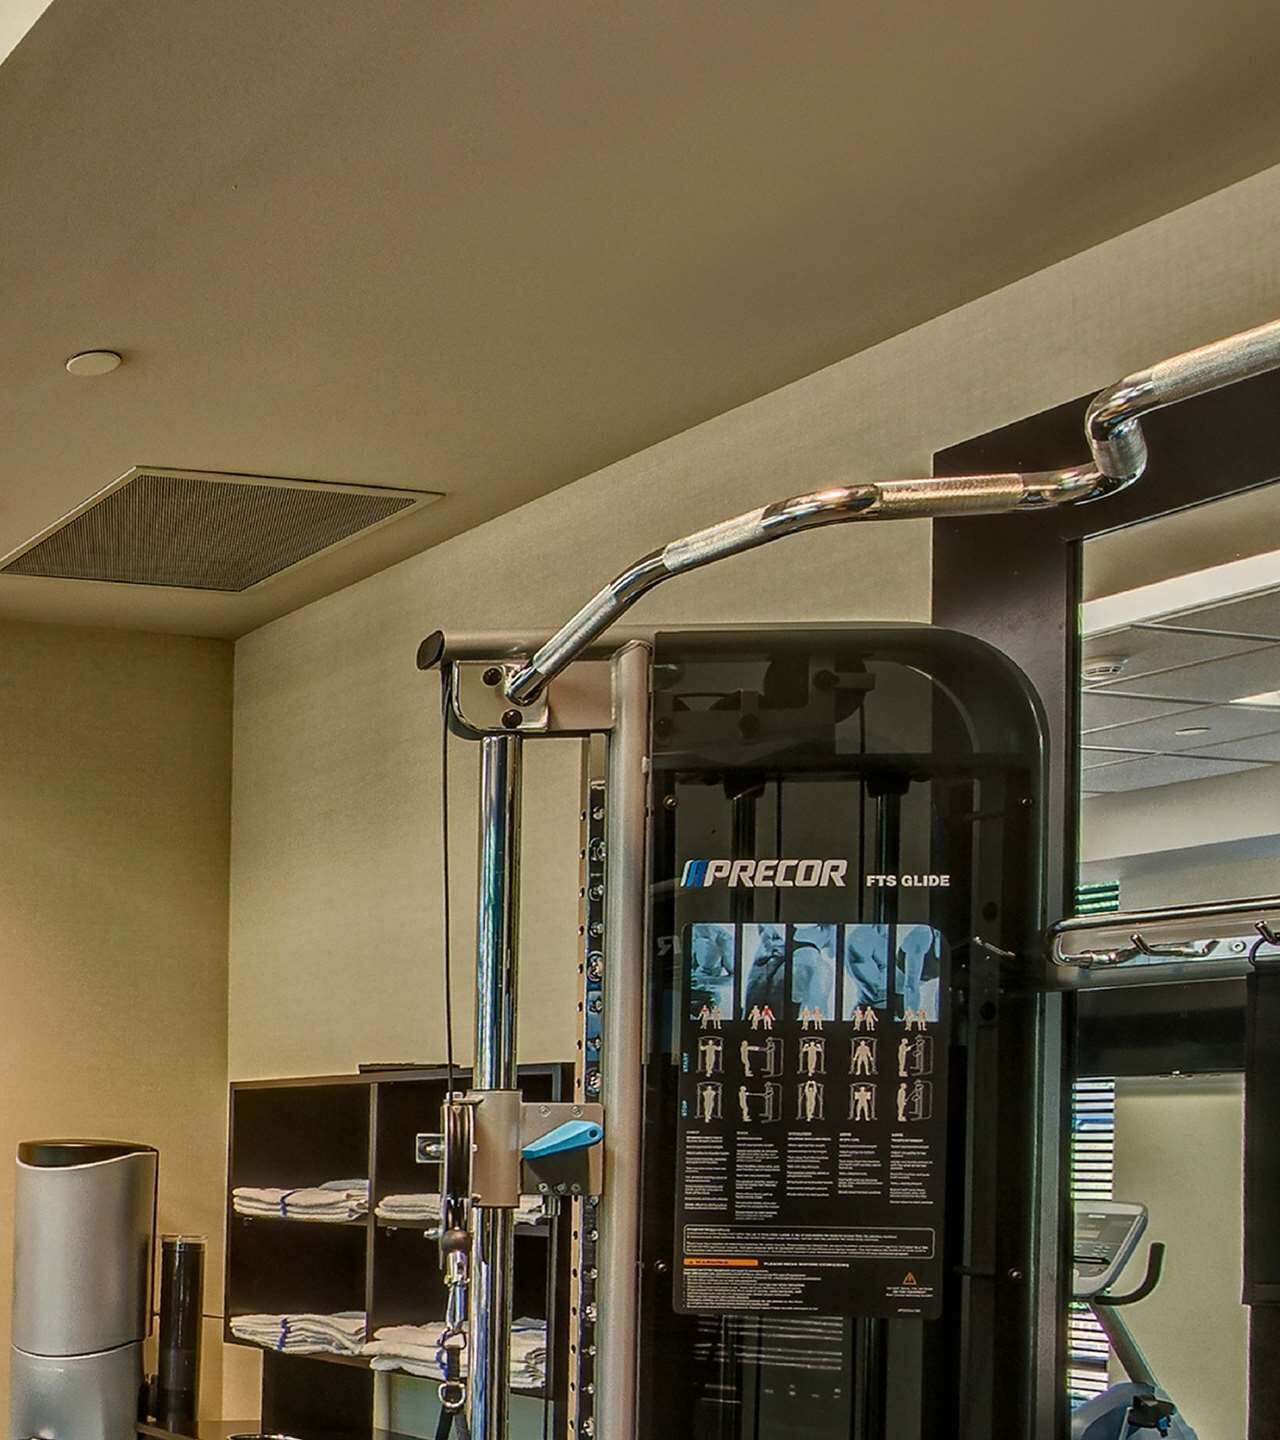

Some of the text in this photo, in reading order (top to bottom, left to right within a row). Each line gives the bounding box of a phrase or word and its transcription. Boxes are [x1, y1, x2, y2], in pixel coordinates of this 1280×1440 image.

[703, 859, 848, 888] PRECOR
[867, 875, 950, 887] FTS GLIDE
